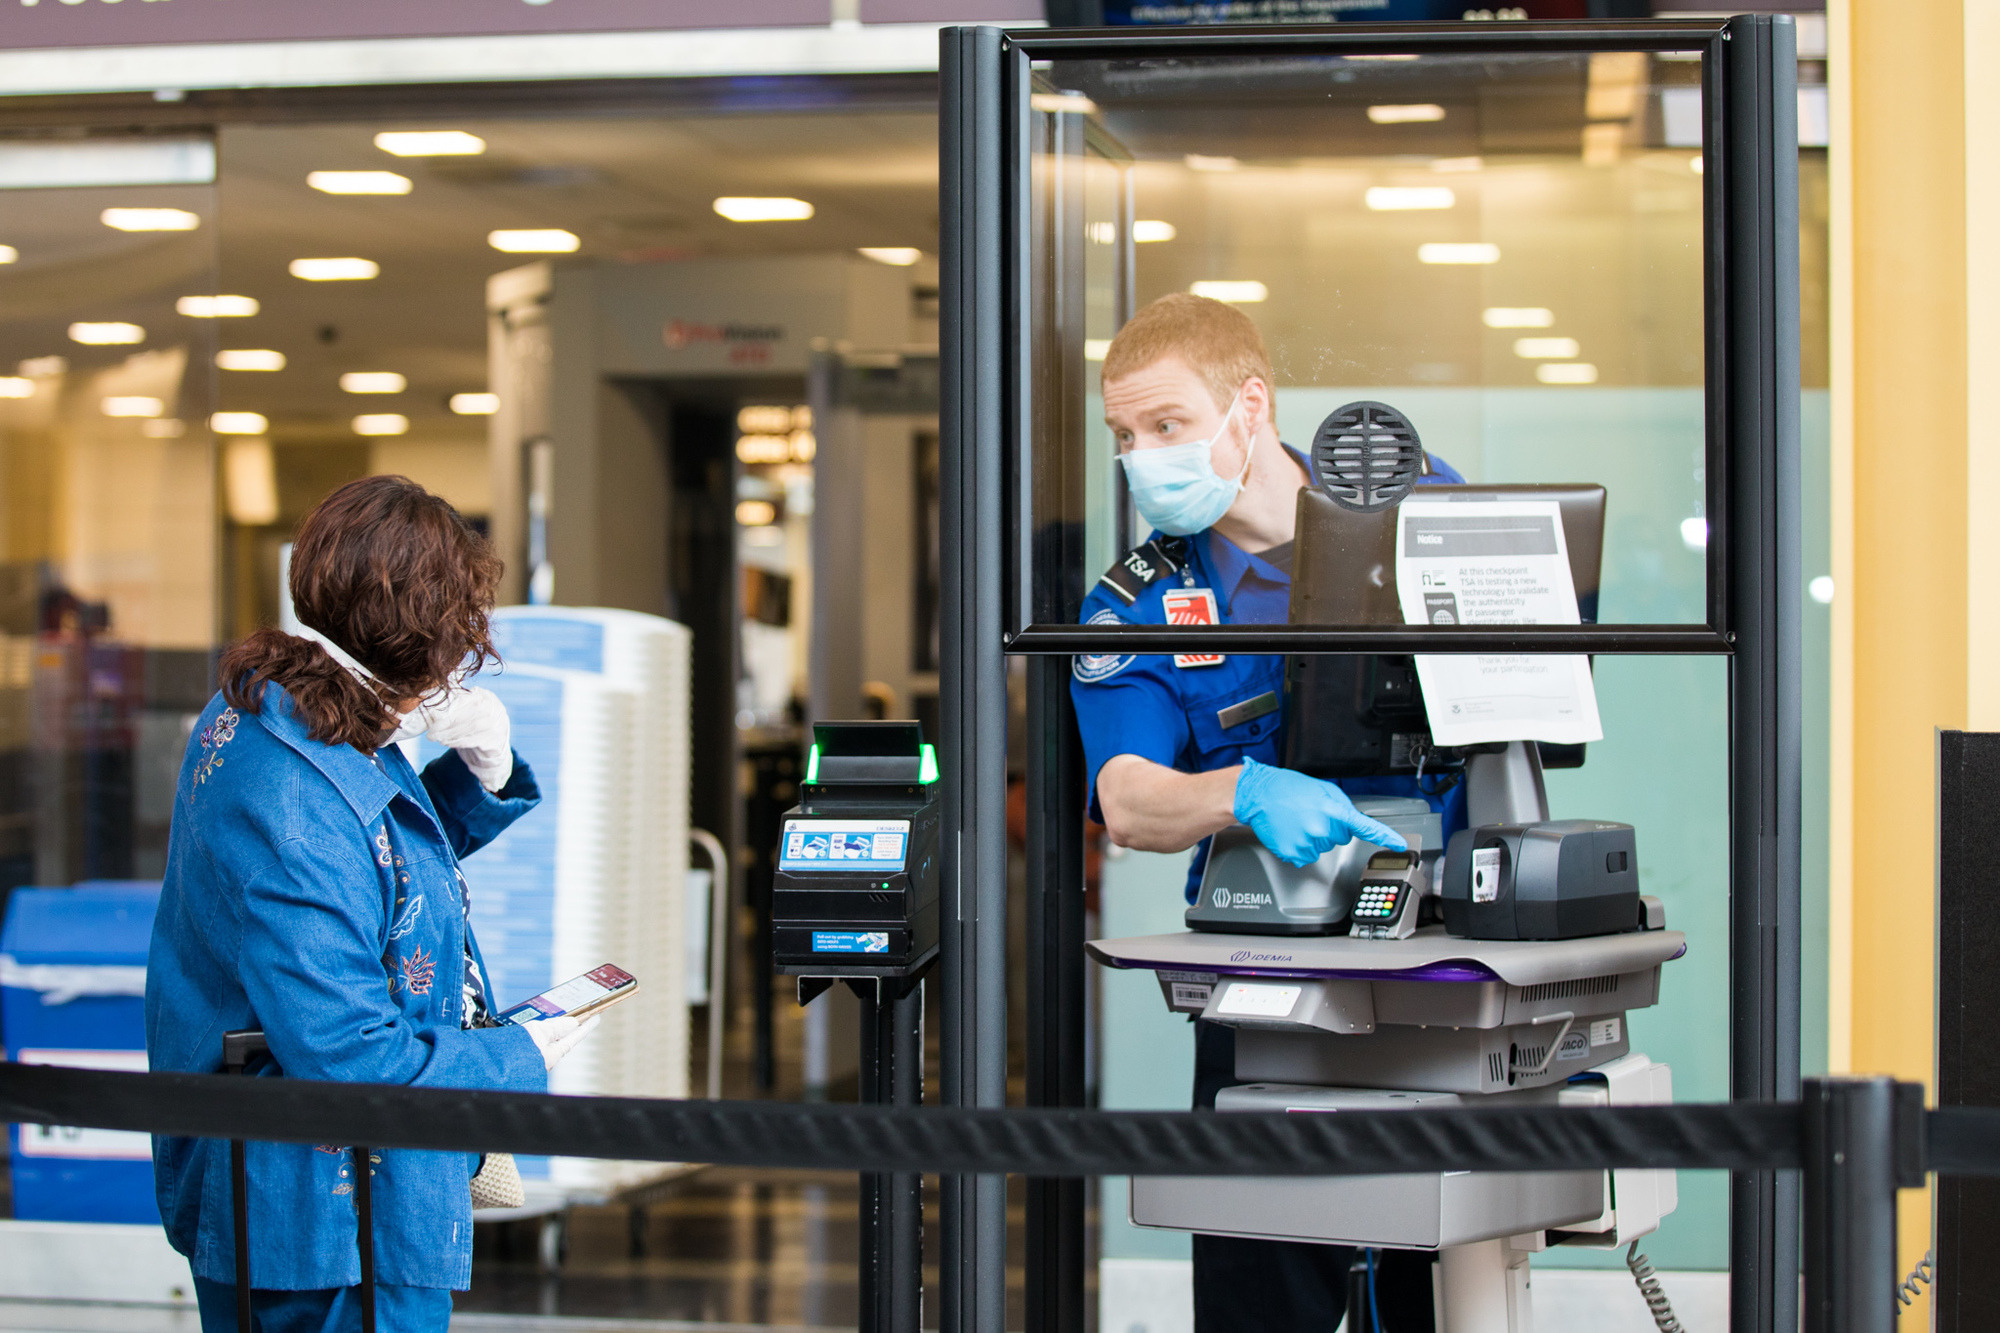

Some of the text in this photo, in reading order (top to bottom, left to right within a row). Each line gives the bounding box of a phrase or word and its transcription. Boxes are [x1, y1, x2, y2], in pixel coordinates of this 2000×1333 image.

[1417, 534, 1443, 545] Notice
[1124, 551, 1155, 582] TSA
[1459, 567, 1528, 577] At this checkpoint
[1461, 578, 1475, 586] TSA
[1478, 578, 1484, 586] is
[1485, 578, 1512, 587] testing
[1462, 588, 1505, 597] technology
[1518, 587, 1549, 595] validate
[1463, 597, 1525, 607] the authenticity
[1465, 608, 1514, 618] of passenger
[1232, 893, 1272, 905] IDEMIA
[1251, 954, 1293, 962] IDEMIA
[1560, 1039, 1584, 1051] JACO
